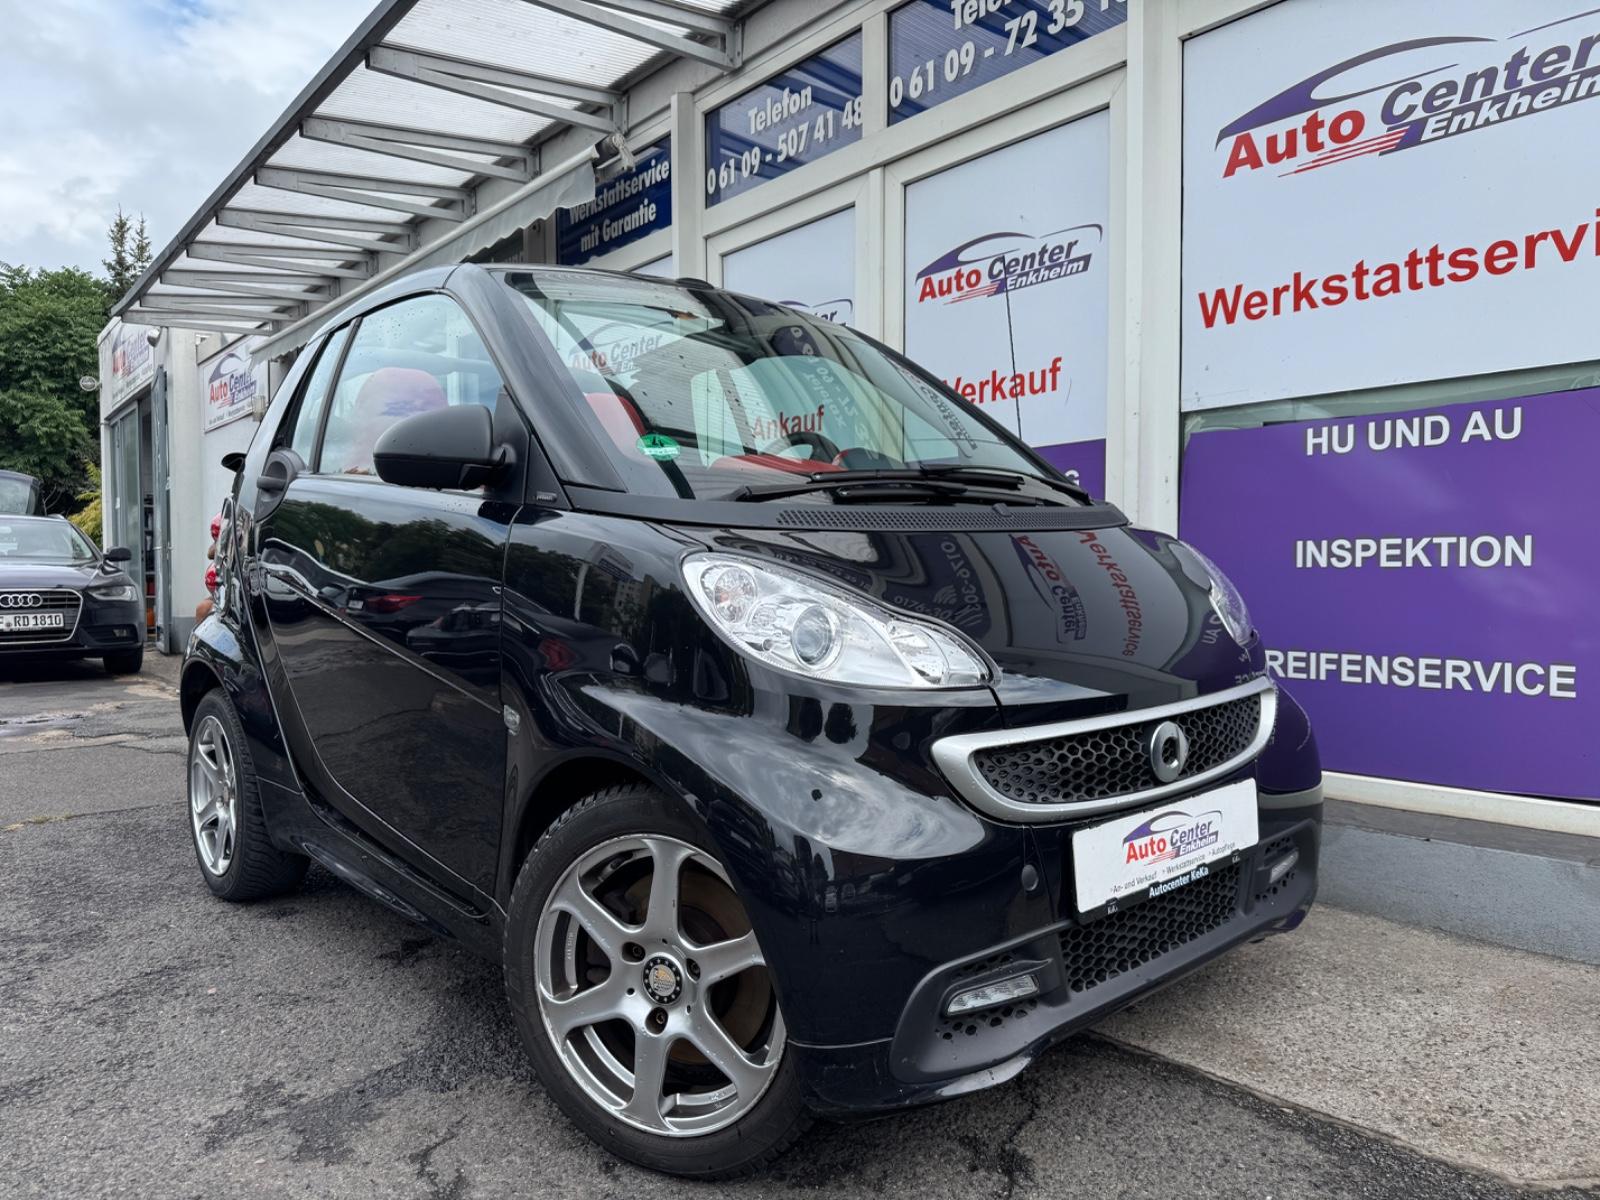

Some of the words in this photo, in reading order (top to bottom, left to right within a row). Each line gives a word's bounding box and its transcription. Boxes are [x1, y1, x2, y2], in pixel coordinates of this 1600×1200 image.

[951, 0, 1011, 30] Tele
[890, 76, 902, 108] 0
[909, 60, 935, 99] 61
[944, 41, 976, 82] 09
[1004, 10, 1038, 56] 72
[1047, 0, 1084, 34] 35
[748, 86, 812, 135] Telefon
[1222, 109, 1366, 178] Auto
[1380, 33, 1600, 126] Center
[707, 168, 716, 194] 0
[719, 158, 735, 189] 61
[742, 147, 761, 178] 09
[777, 121, 809, 162] 507
[814, 110, 833, 143] 41
[842, 95, 863, 130] 48
[569, 158, 670, 225] Werkstattservice
[580, 223, 600, 252] mit
[602, 198, 657, 242] Garantie
[918, 267, 982, 303] Auto
[988, 239, 1080, 280] Center
[1003, 258, 1085, 292] Enkheim
[611, 335, 663, 362] Center
[210, 381, 228, 404] Auto
[754, 404, 825, 440] Ankauf
[1306, 424, 1355, 456] HU
[1367, 415, 1450, 450] UND
[1461, 407, 1522, 443] AU
[1296, 535, 1533, 569] INSPEKTION
[14, 615, 30, 627] RD
[32, 614, 62, 626] 1810
[1265, 649, 1577, 699] REIFENSERVICE
[1126, 837, 1167, 865] Auto
[1170, 821, 1213, 847] Center
[1180, 834, 1217, 853] Enkheim
[1149, 873, 1190, 899] Autocenter
[1190, 866, 1209, 881] KeKa
